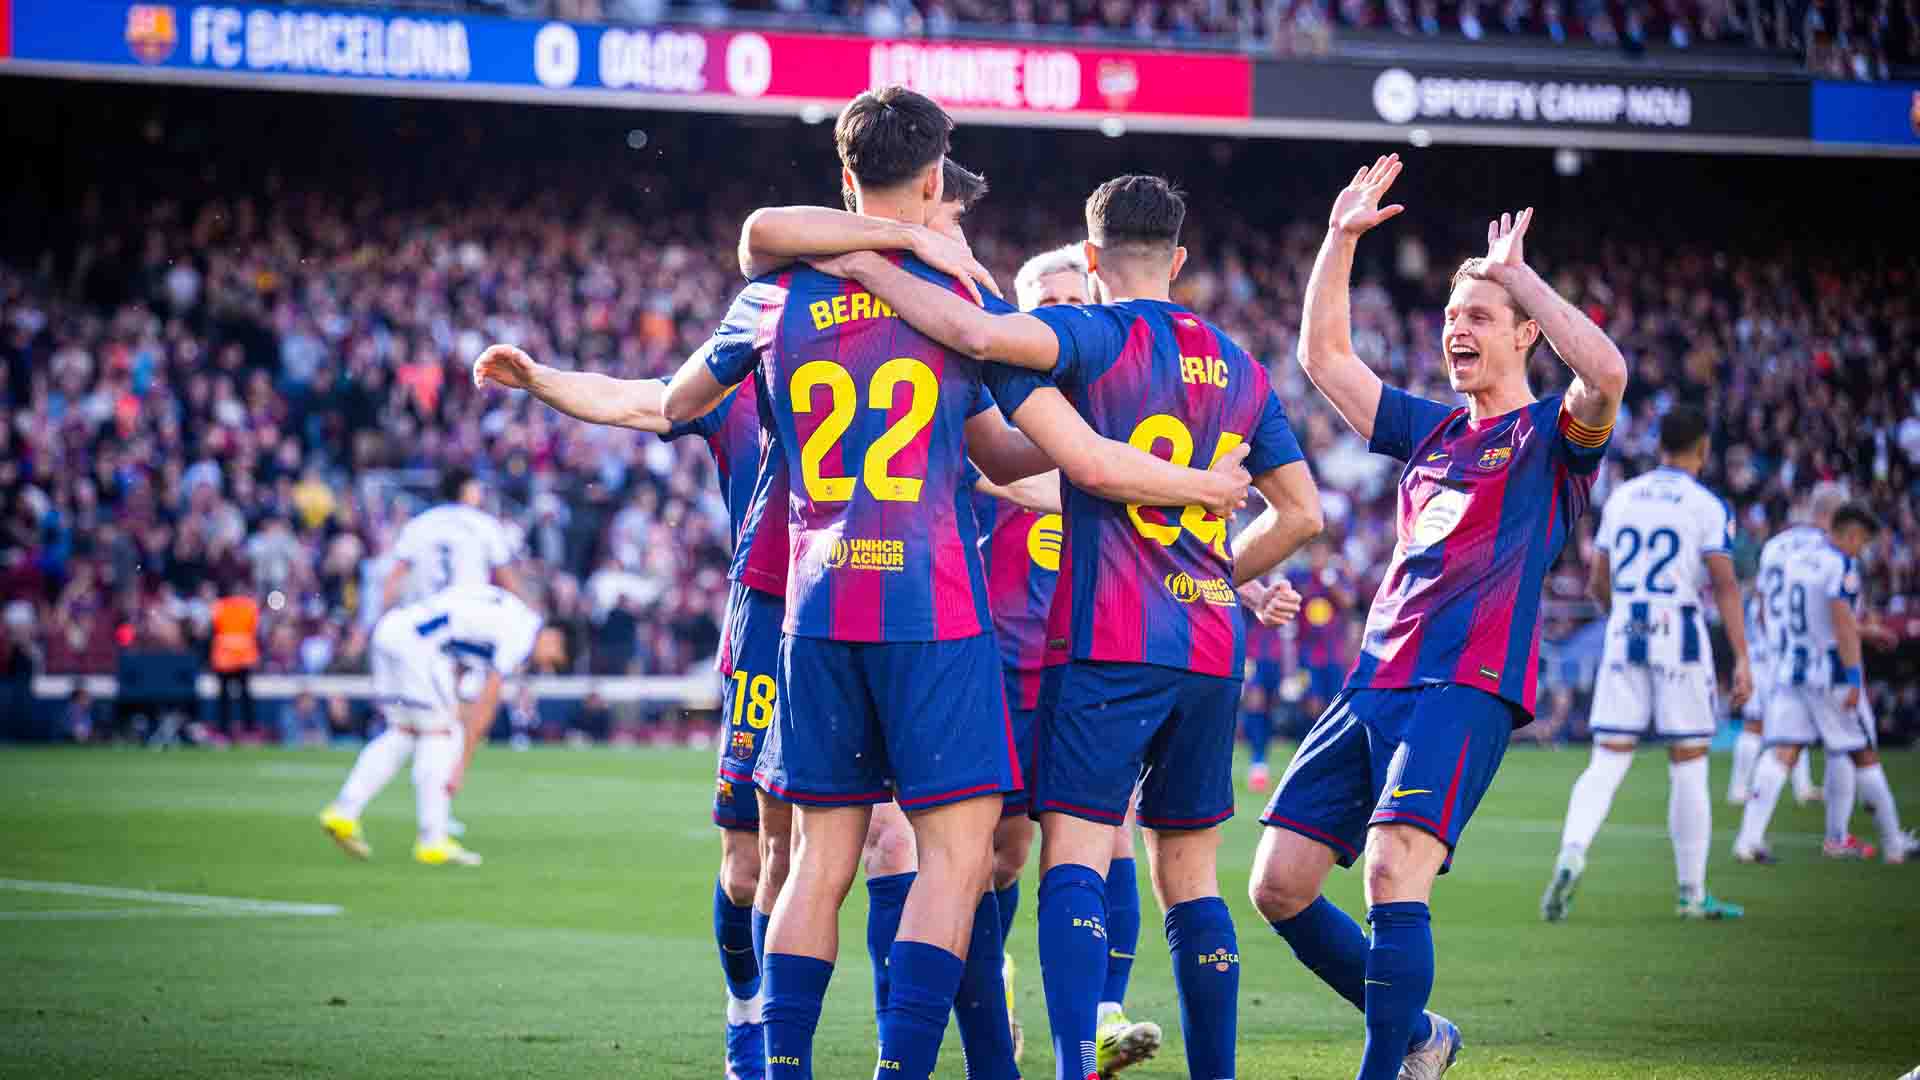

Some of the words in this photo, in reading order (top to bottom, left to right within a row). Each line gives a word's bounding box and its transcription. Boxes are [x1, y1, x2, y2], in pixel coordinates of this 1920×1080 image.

[191, 7, 243, 68] FC
[246, 9, 471, 80] BARCELONA
[533, 22, 580, 89] 0
[725, 33, 772, 98] 0
[1024, 49, 1081, 110] UD
[1419, 77, 1538, 120] SPOTIFY
[1540, 82, 1623, 122] CAMP
[1627, 86, 1692, 126] NOU
[808, 293, 898, 331] BERN
[789, 357, 939, 503] 22
[850, 539, 904, 553] UNHCR
[850, 551, 904, 566] ACNUR
[1613, 526, 1680, 594] 22
[731, 670, 776, 730] 18
